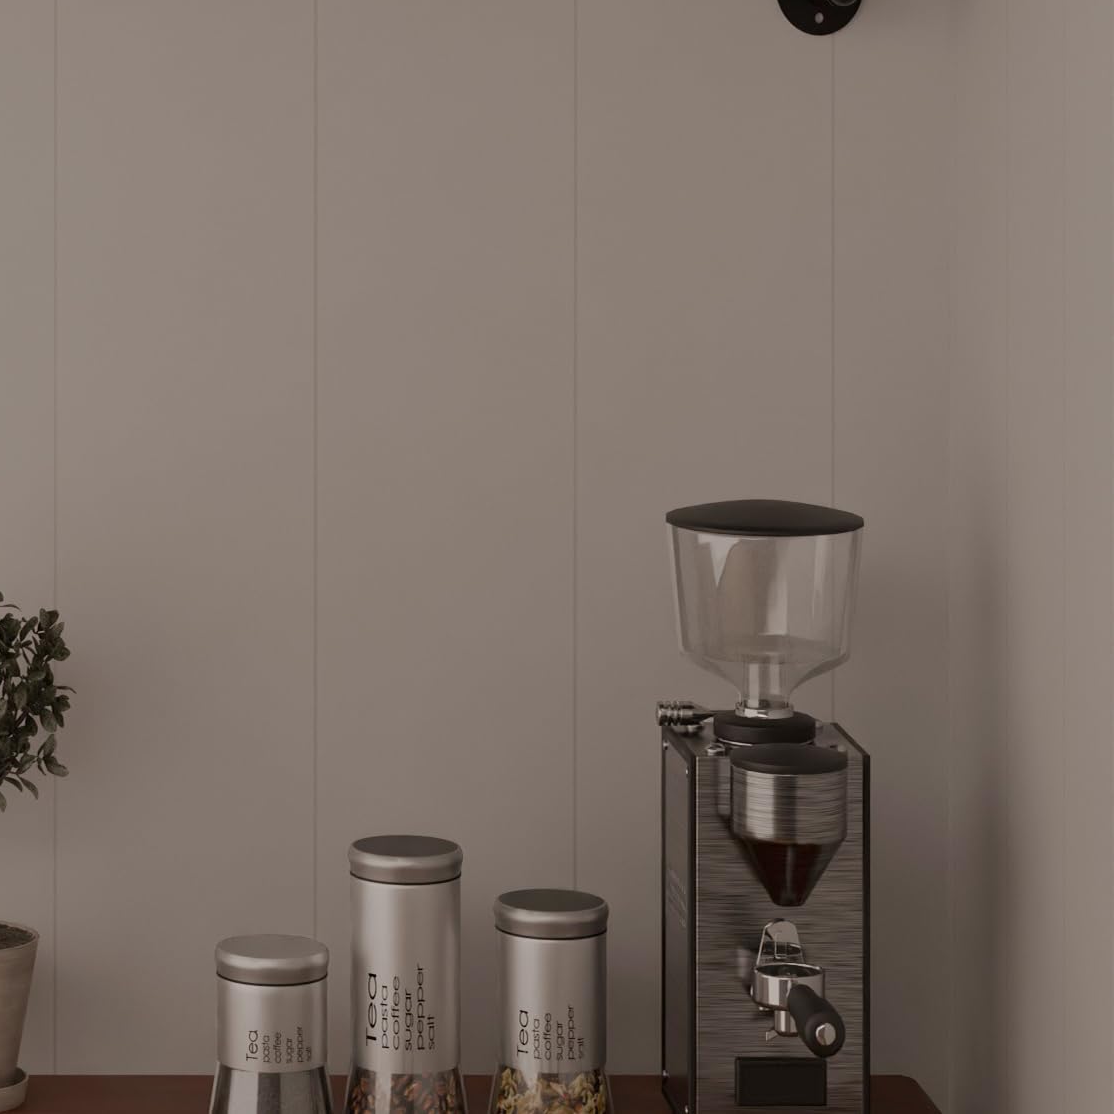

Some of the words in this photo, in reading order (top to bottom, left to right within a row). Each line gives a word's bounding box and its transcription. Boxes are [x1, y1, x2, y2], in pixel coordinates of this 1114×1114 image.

[366, 972, 377, 1046] Tea
[380, 985, 390, 1049] pasta
[391, 975, 400, 1051] coffee
[405, 988, 414, 1051] sugar
[417, 963, 426, 1051] pepper
[246, 1030, 259, 1061] Tea
[261, 1035, 271, 1063] pasta
[273, 1031, 282, 1064] coffee
[516, 1009, 529, 1057] Tea
[533, 1018, 542, 1060] pasta
[543, 1012, 552, 1061] coffee
[556, 1021, 565, 1061] sugar
[567, 1005, 576, 1060] pepper
